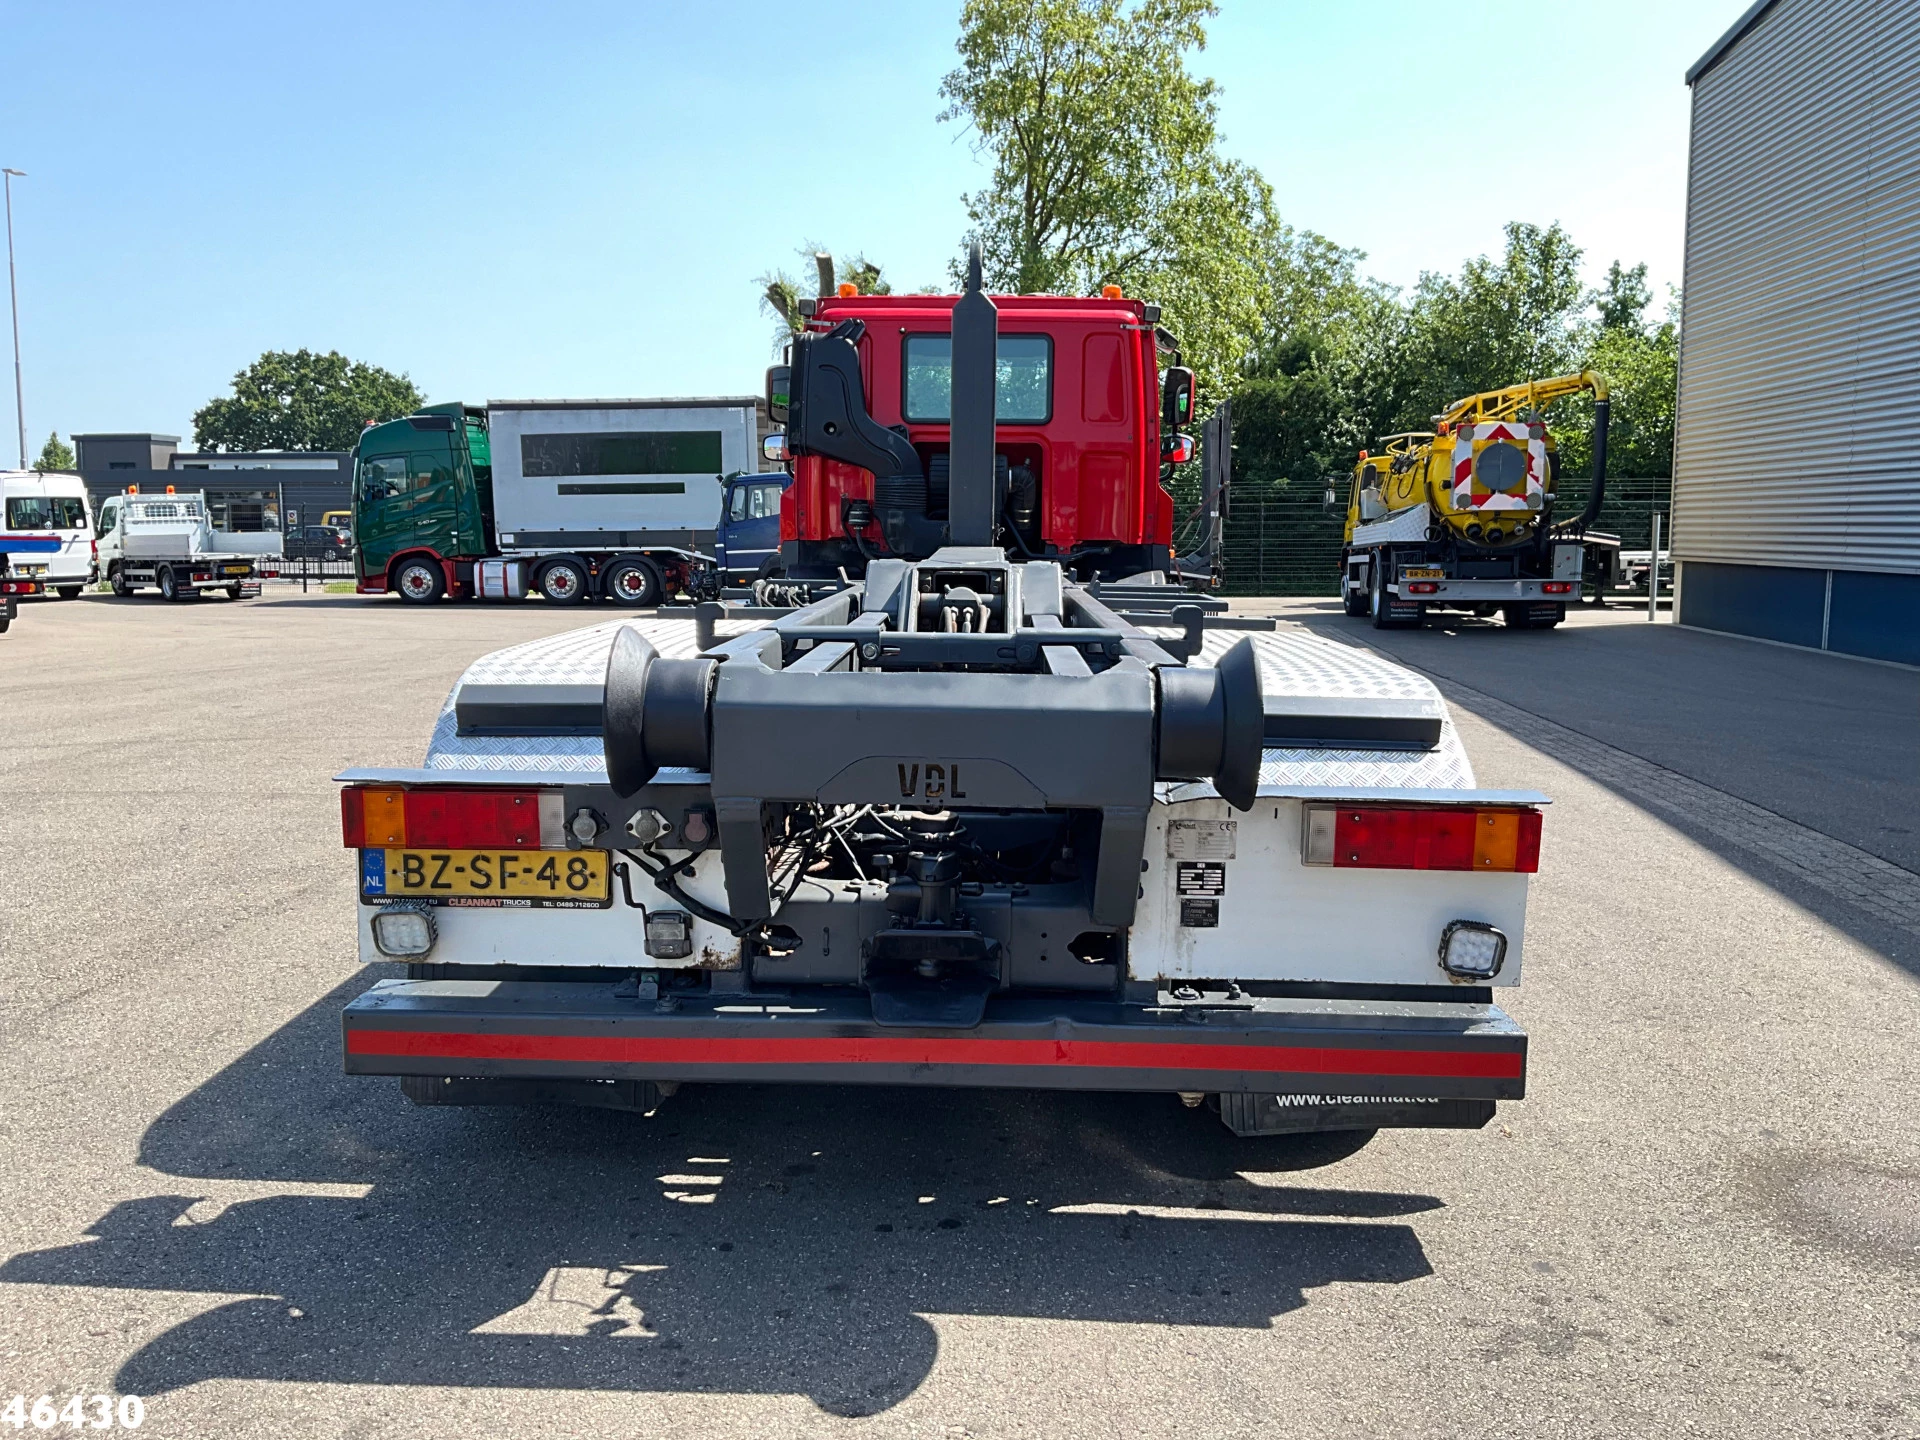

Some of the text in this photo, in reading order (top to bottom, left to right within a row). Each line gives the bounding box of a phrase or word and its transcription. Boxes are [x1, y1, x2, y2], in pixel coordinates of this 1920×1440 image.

[897, 763, 966, 798] VDL
[366, 875, 383, 887] NL
[402, 853, 589, 891] BZ-SF-48
